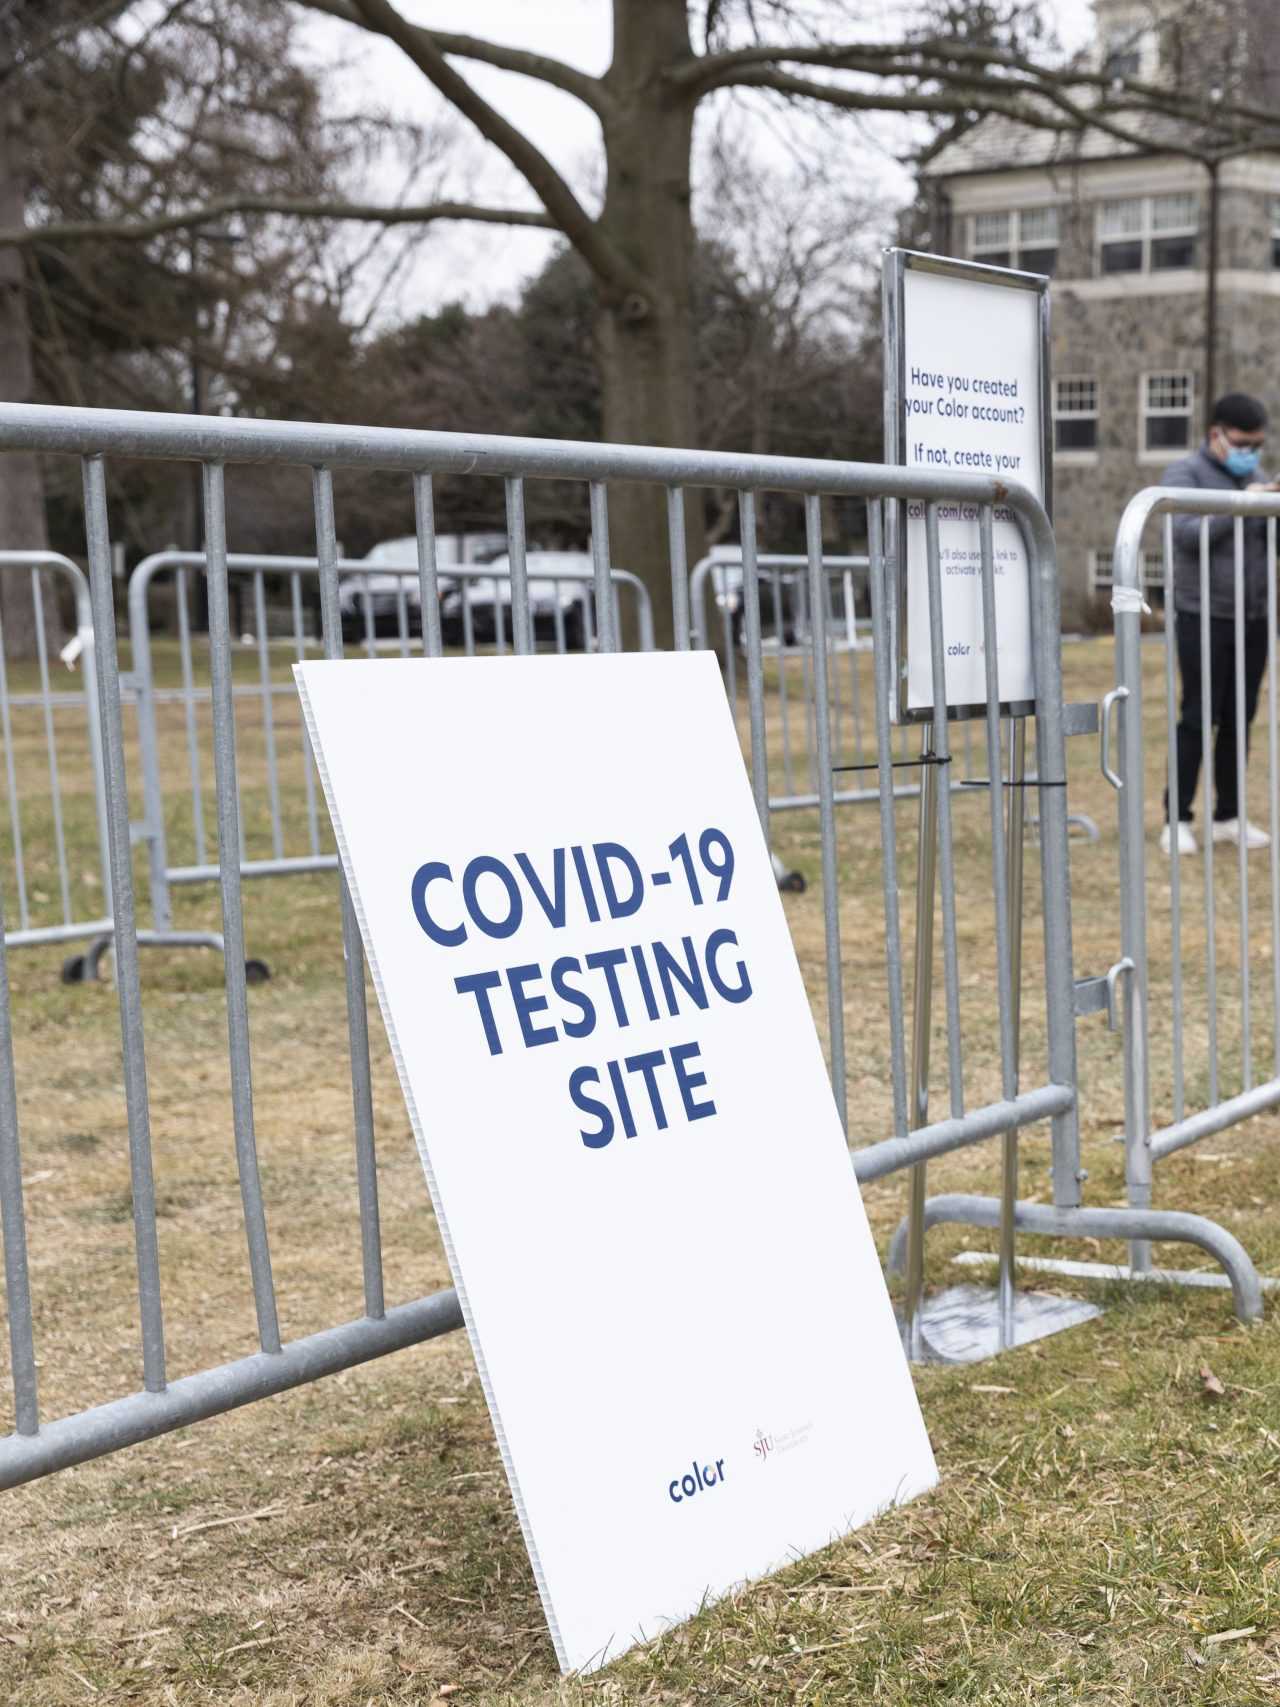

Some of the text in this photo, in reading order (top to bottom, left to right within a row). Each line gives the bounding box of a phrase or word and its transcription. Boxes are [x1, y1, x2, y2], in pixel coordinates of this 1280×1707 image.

[911, 367, 1018, 397] Have you created
[905, 398, 1025, 424] your Color account?
[914, 443, 1020, 472] If not, create your
[952, 548, 967, 560] also
[946, 565, 976, 575] activate
[947, 642, 971, 656] color
[411, 828, 735, 947] COVID-19
[454, 928, 753, 1056] TESTING
[569, 1041, 717, 1149] SITE
[669, 1458, 724, 1502] color
